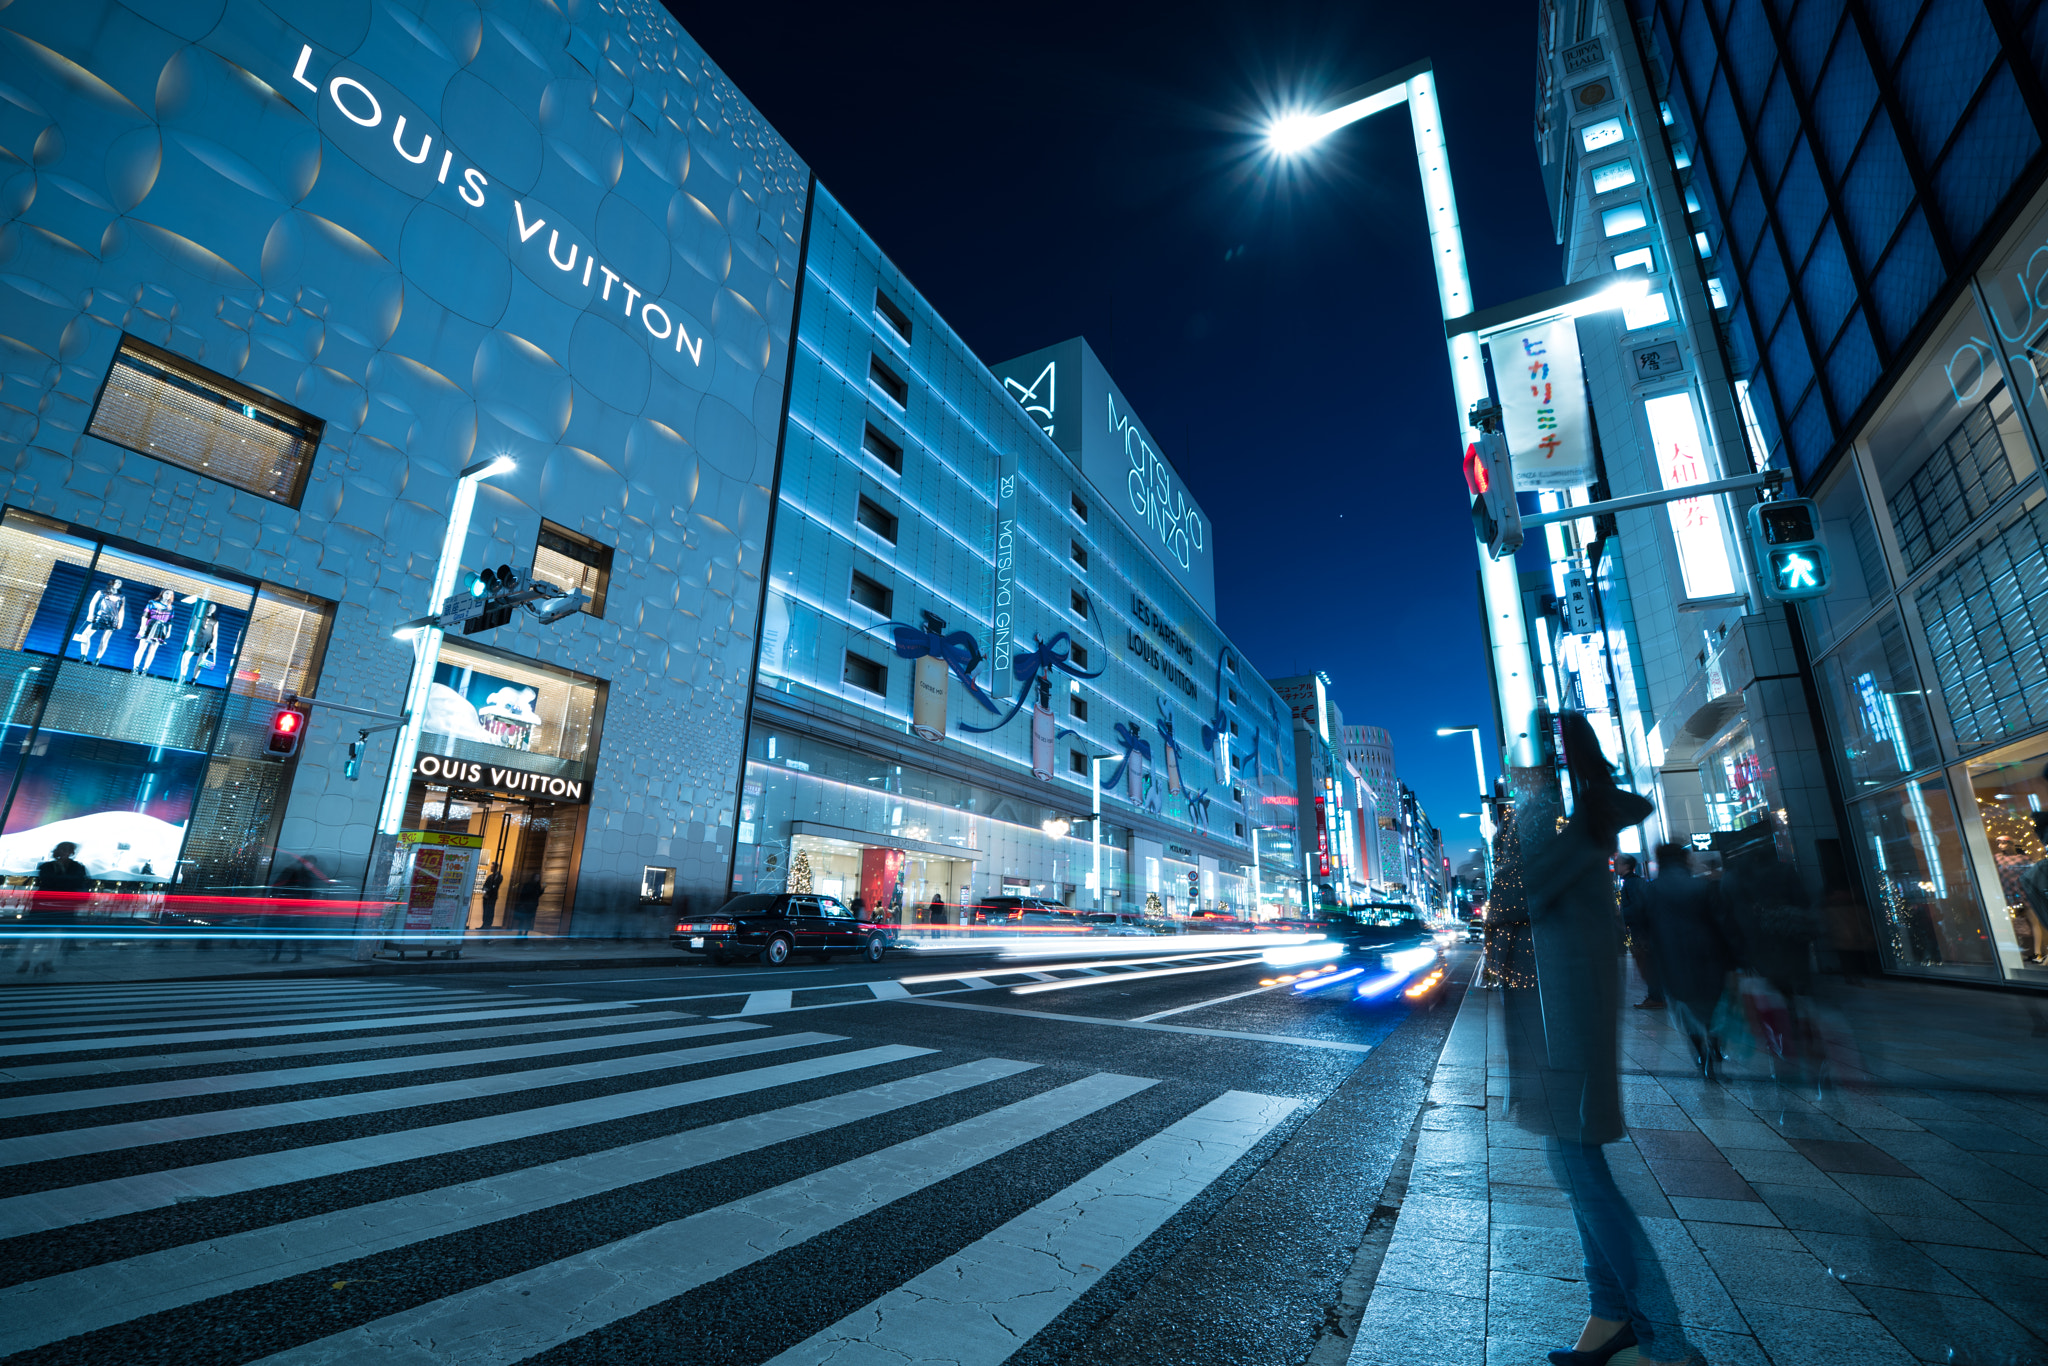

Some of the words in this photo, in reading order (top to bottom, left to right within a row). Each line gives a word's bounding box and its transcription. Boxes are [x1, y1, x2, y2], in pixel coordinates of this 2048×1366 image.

[1566, 43, 1599, 61] JUJIYA
[1569, 54, 1600, 70] HALL
[292, 43, 488, 209] LOUIS
[513, 199, 704, 368] VUITTON
[1521, 337, 1562, 460] ヒカリミチ
[1569, 577, 1588, 628] 南風ビル
[1131, 593, 1151, 627] LES
[1153, 612, 1193, 666] PARFUMS
[1127, 627, 1160, 671] LOUIS
[1161, 655, 1198, 702] VUITTON
[1273, 683, 1314, 694] ニューアル
[412, 755, 482, 783] OUIS
[490, 767, 582, 800] VUITTON
[437, 834, 469, 847] 宝くじ
